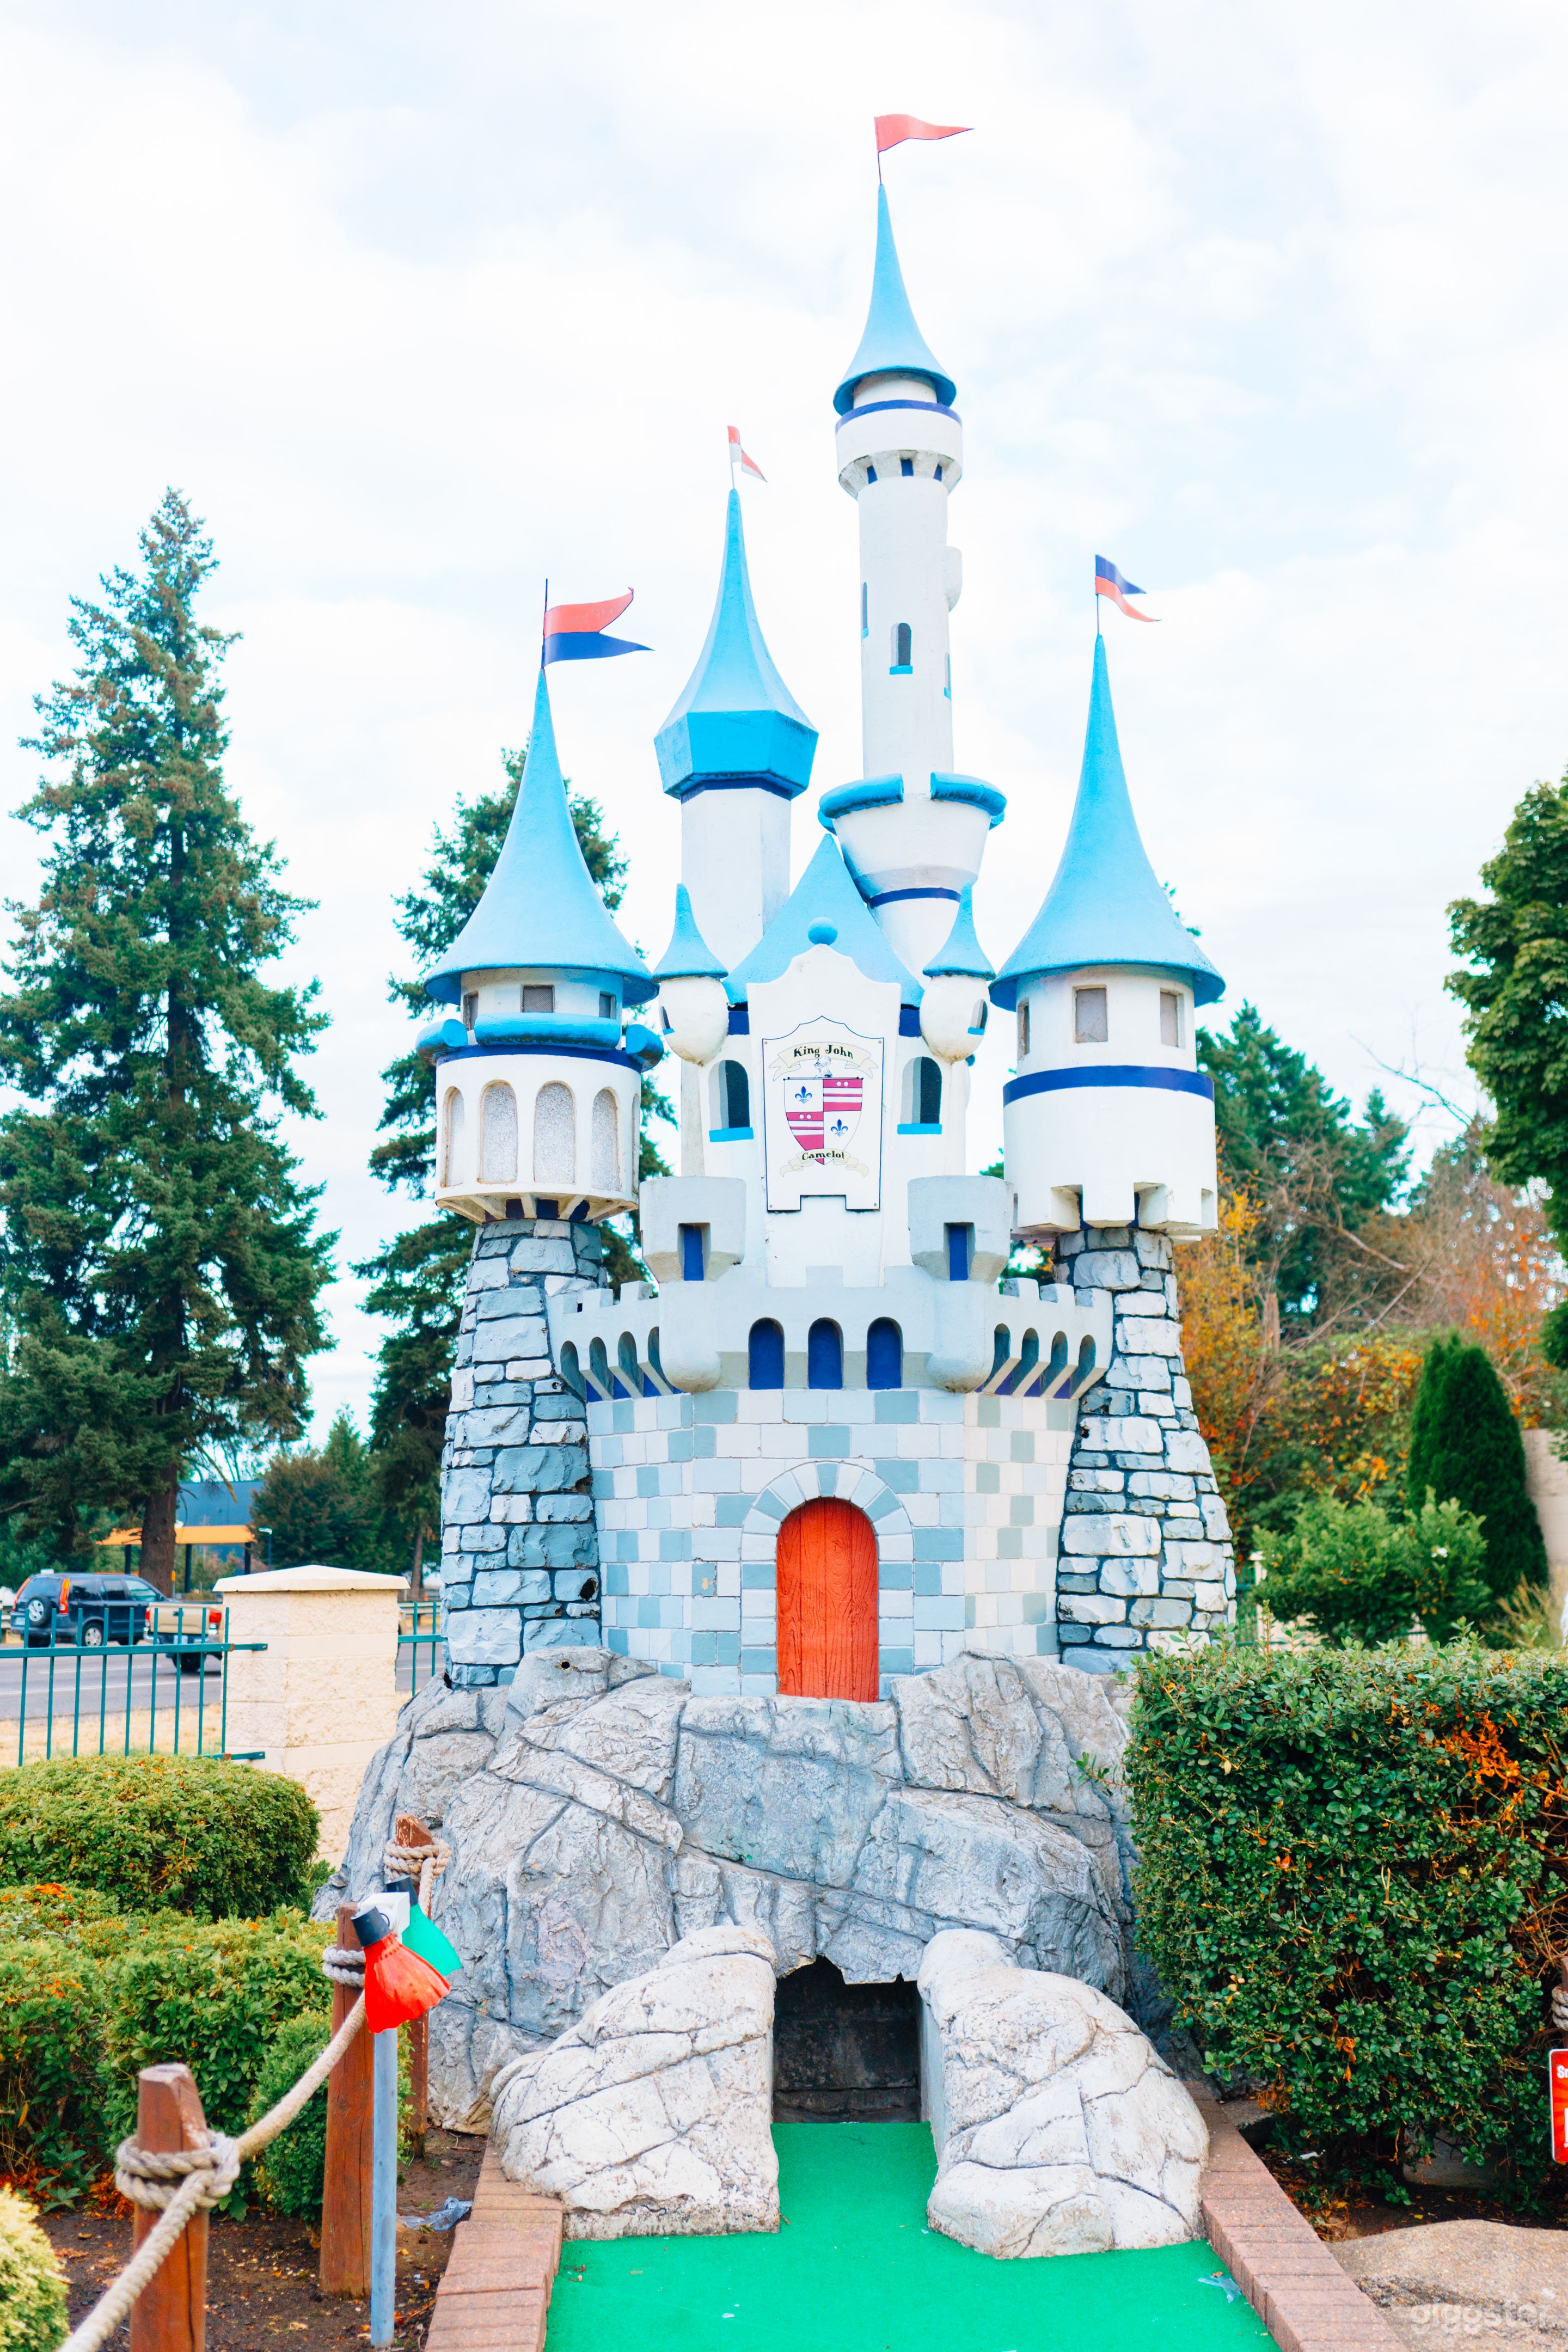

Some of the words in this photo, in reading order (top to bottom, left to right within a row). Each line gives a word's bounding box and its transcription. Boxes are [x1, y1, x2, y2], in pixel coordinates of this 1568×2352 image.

[794, 1046, 820, 1058] King
[825, 1044, 853, 1059] John
[802, 1150, 844, 1160] Camelot
